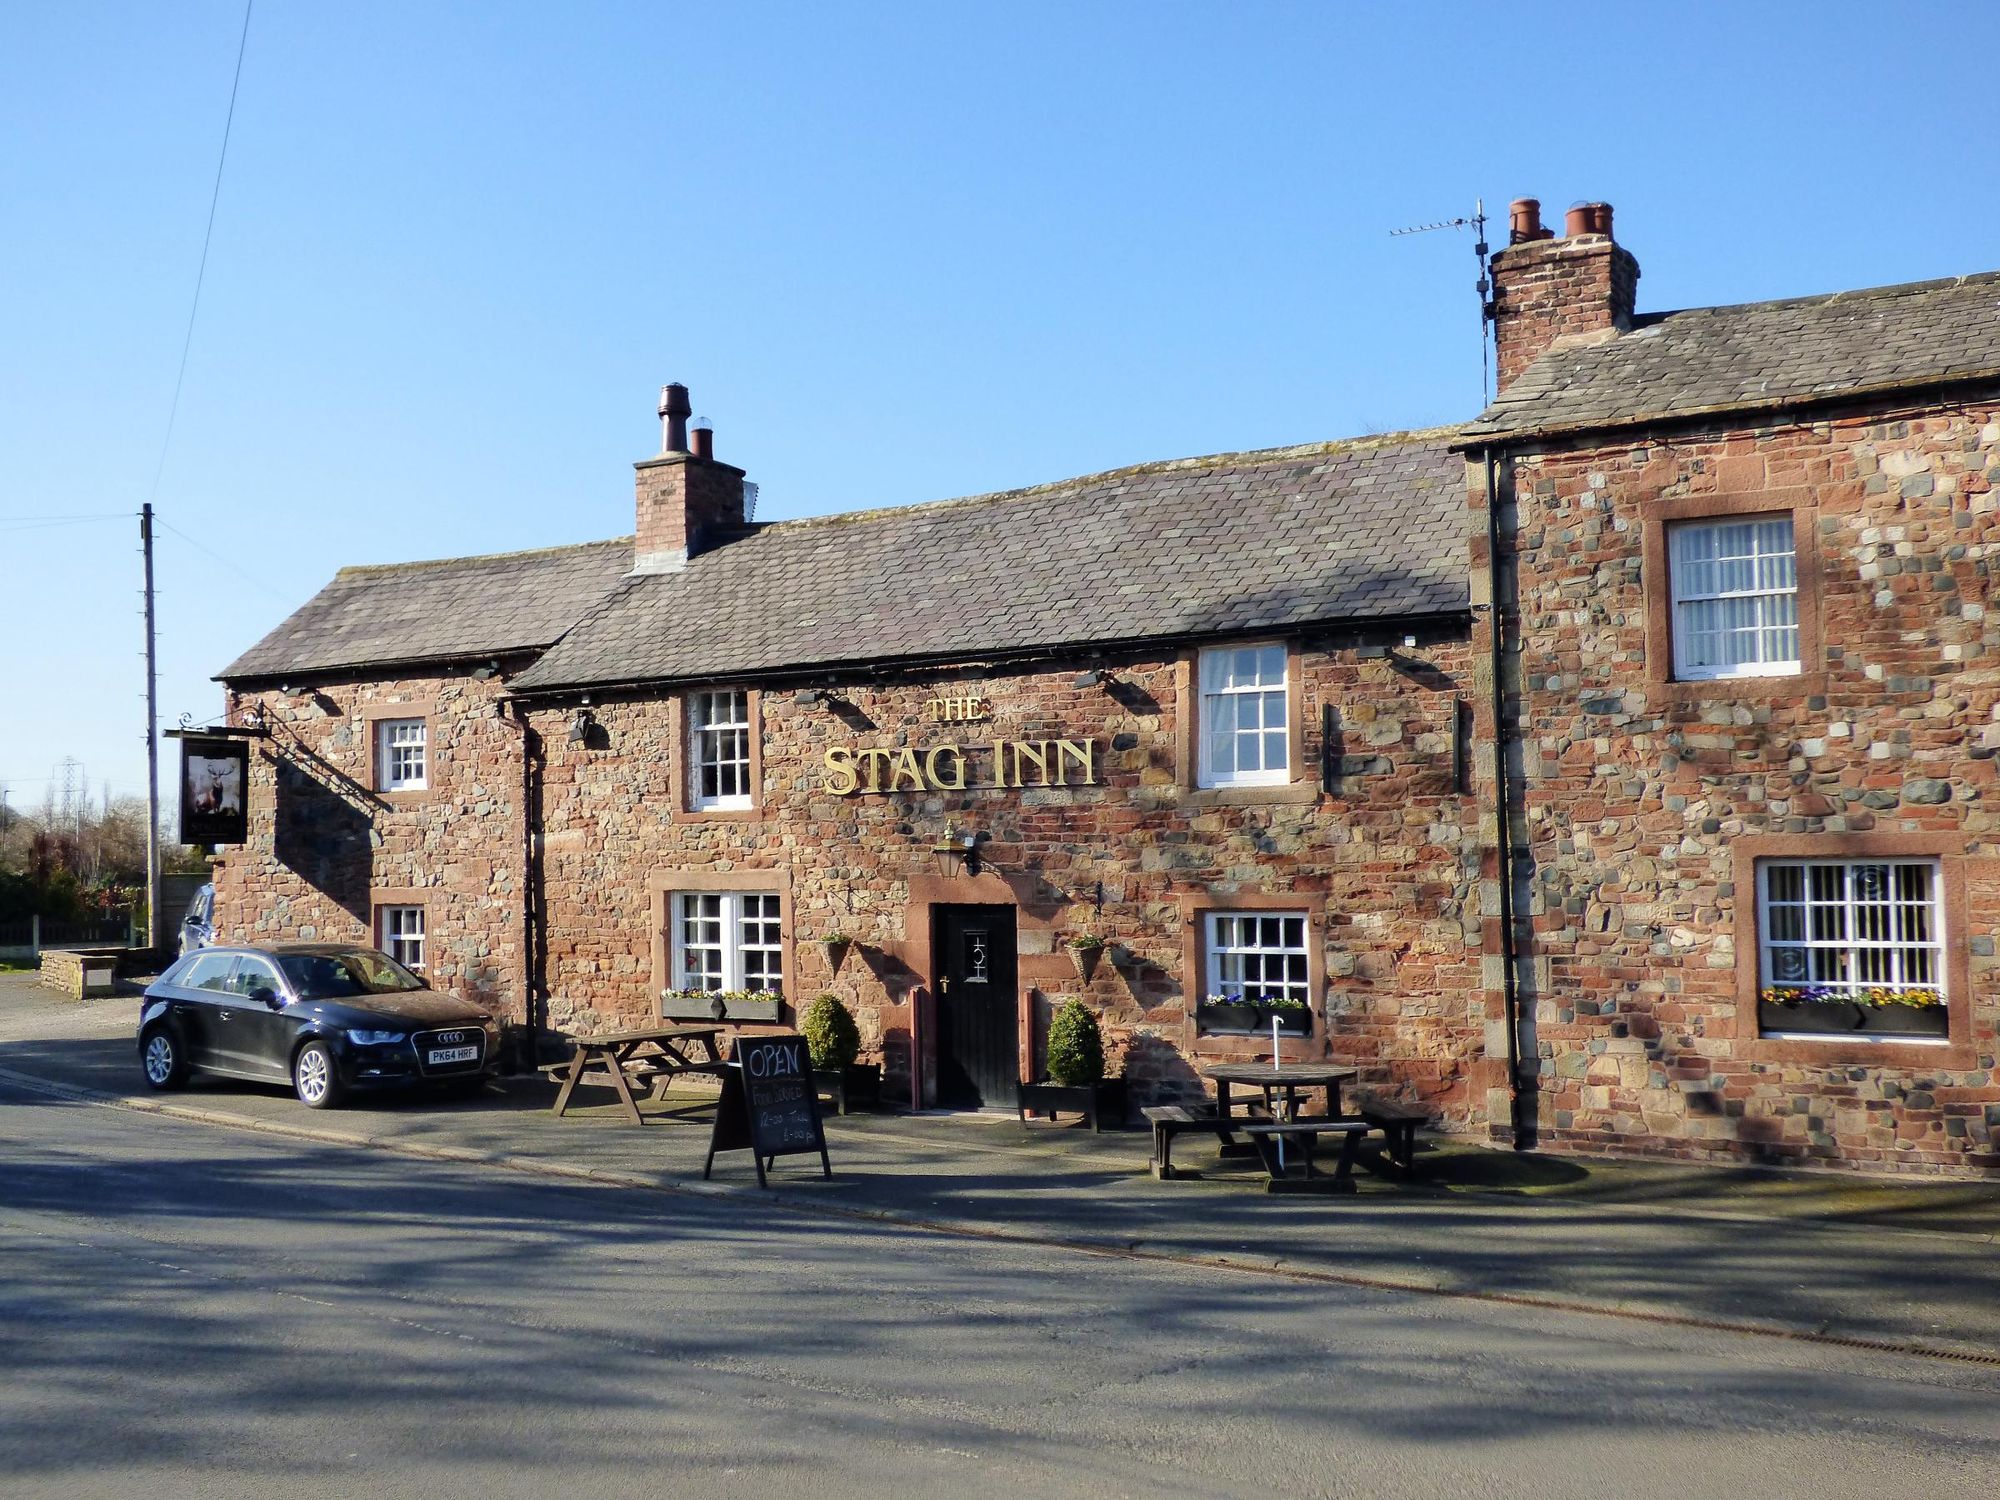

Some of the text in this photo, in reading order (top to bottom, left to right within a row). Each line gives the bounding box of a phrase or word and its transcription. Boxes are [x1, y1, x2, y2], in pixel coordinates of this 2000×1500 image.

[926, 696, 983, 722] THE
[823, 737, 1097, 795] STAG INN
[433, 1048, 473, 1062] PK64 HRF
[749, 1044, 800, 1077] OPEN
